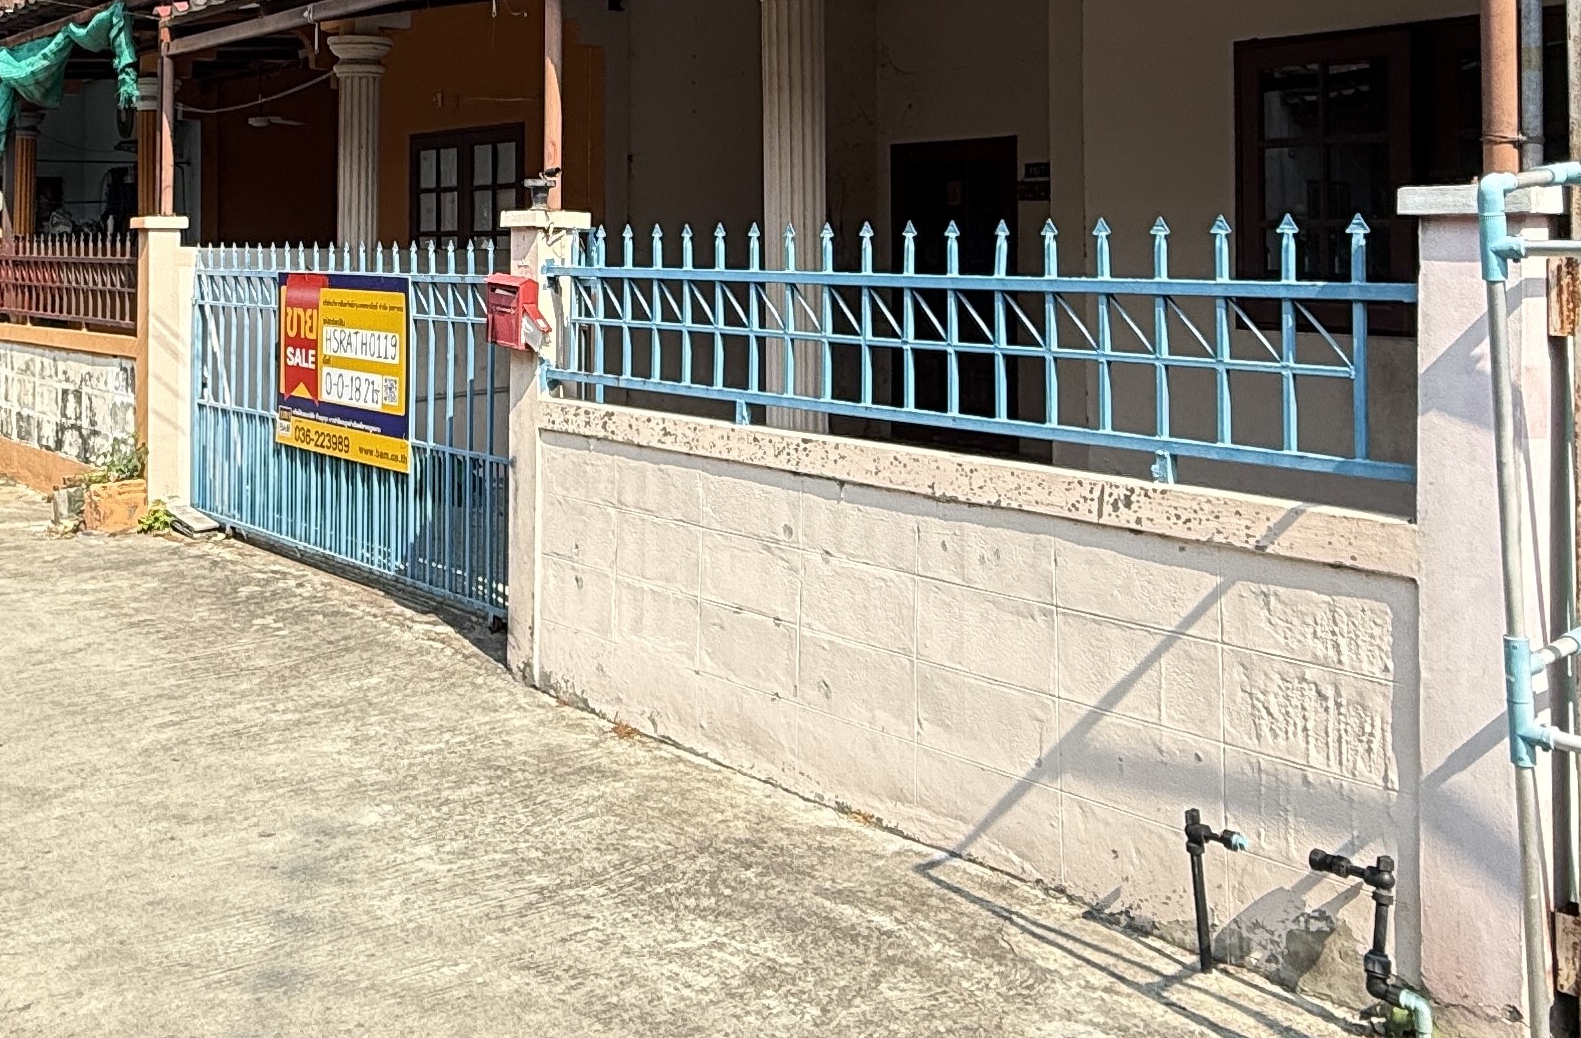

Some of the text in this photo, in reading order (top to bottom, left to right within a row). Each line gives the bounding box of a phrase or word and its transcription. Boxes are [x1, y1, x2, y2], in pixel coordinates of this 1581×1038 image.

[286, 306, 318, 340] ขาย
[286, 346, 316, 370] SALE
[325, 328, 397, 361] HSRATH0119
[294, 424, 350, 454] 036-223989
